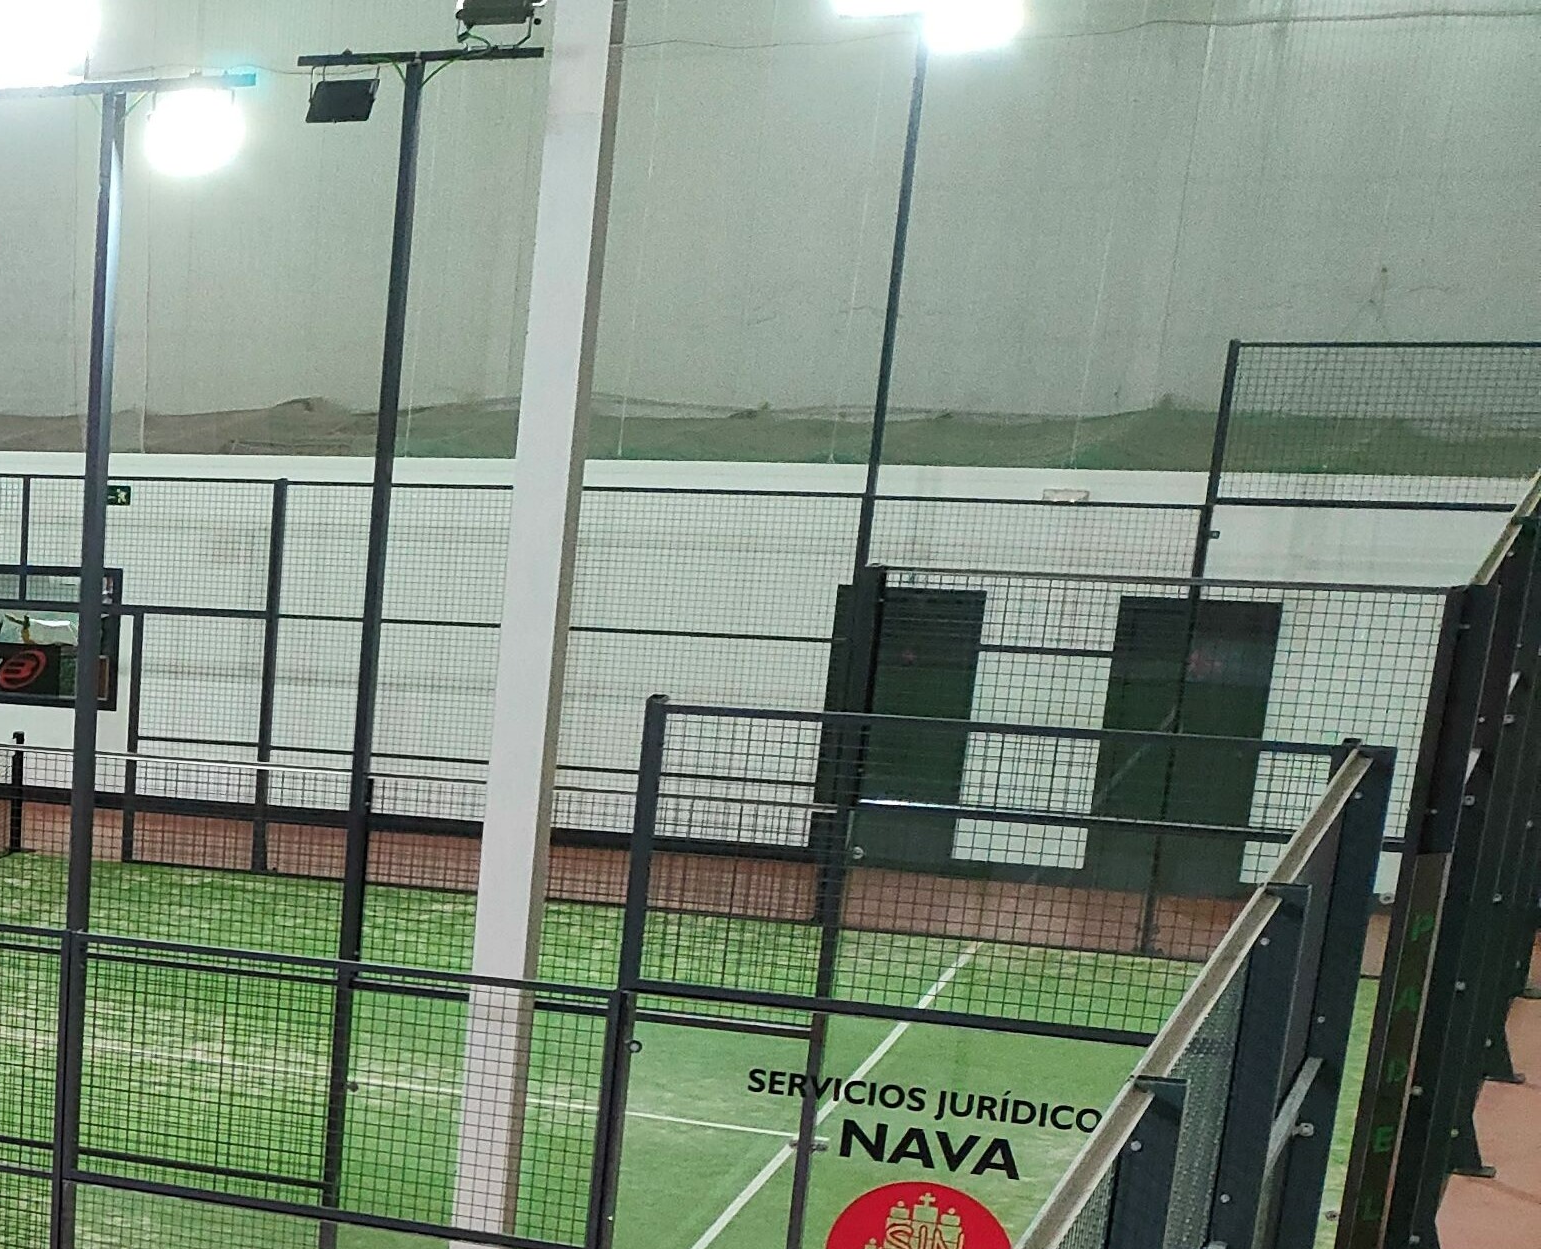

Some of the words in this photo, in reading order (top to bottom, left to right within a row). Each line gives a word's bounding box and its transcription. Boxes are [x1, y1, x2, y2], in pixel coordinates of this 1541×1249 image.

[747, 1068, 926, 1112] SERVICIOS
[936, 1090, 1102, 1133] JURÍDICO
[839, 1119, 1020, 1180] NAVA
